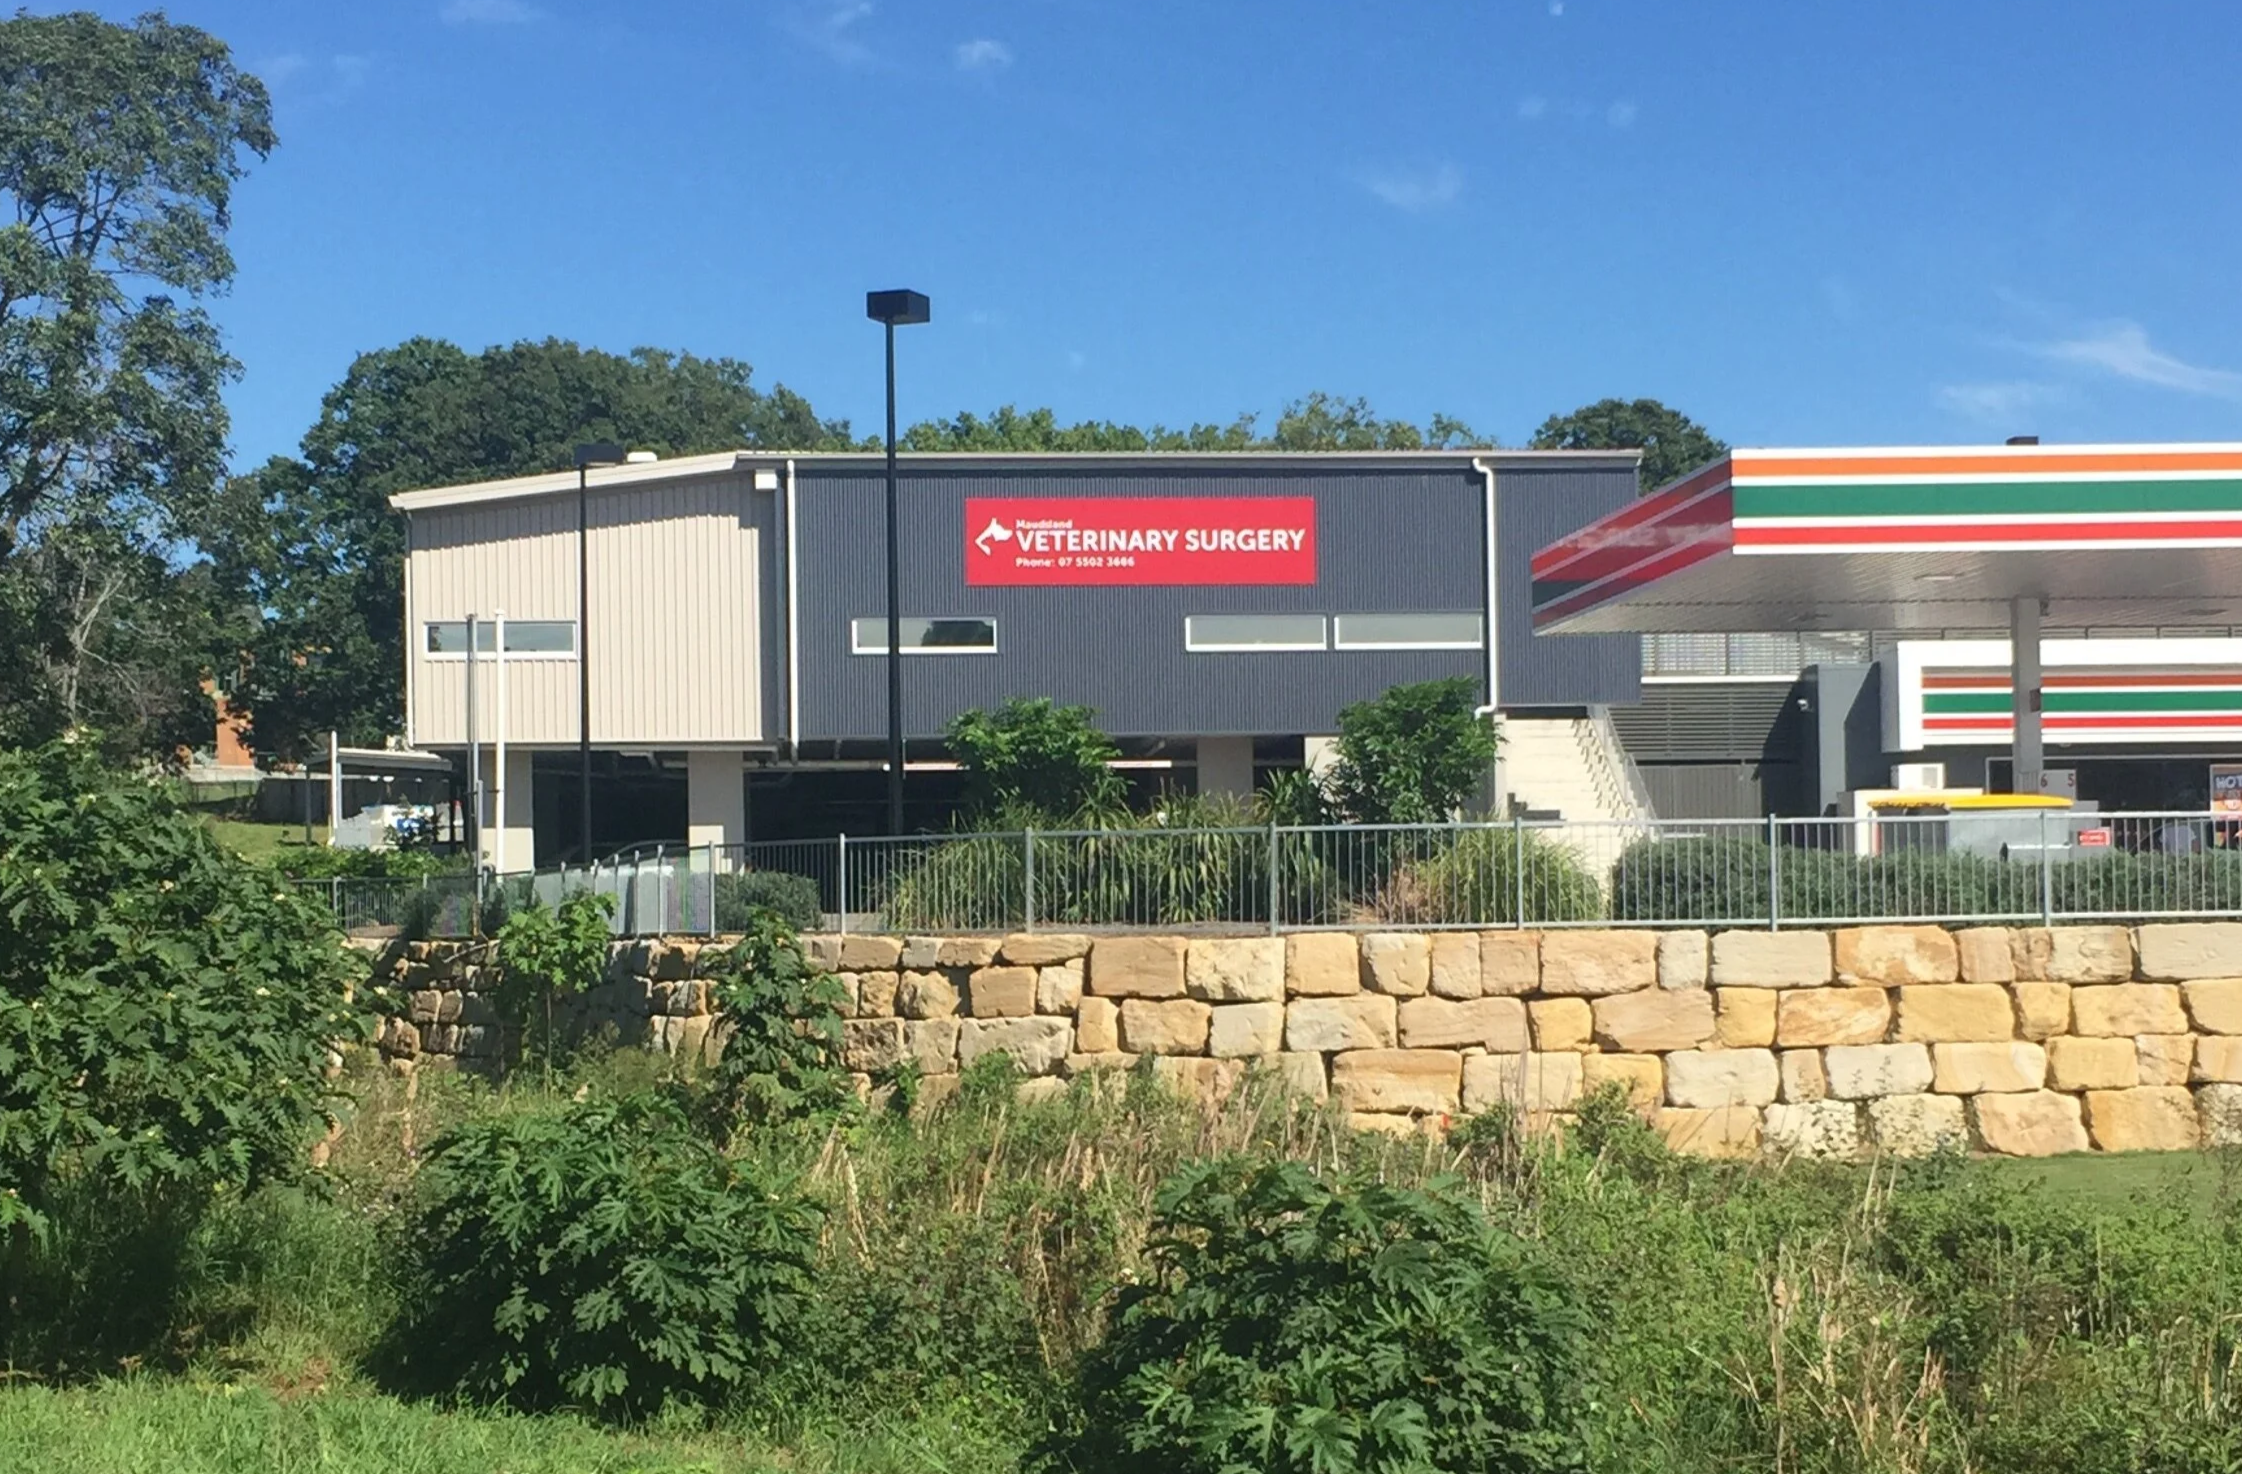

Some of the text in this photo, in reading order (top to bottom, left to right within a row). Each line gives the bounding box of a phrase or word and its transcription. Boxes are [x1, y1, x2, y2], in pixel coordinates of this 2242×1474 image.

[1016, 529, 1306, 551] VETERINARY SURGERY
[1015, 556, 1055, 567] Phone:
[1057, 556, 1073, 567] 07
[1076, 556, 1103, 567] 5502
[2040, 773, 2048, 787] 6
[2067, 773, 2075, 787] 5
